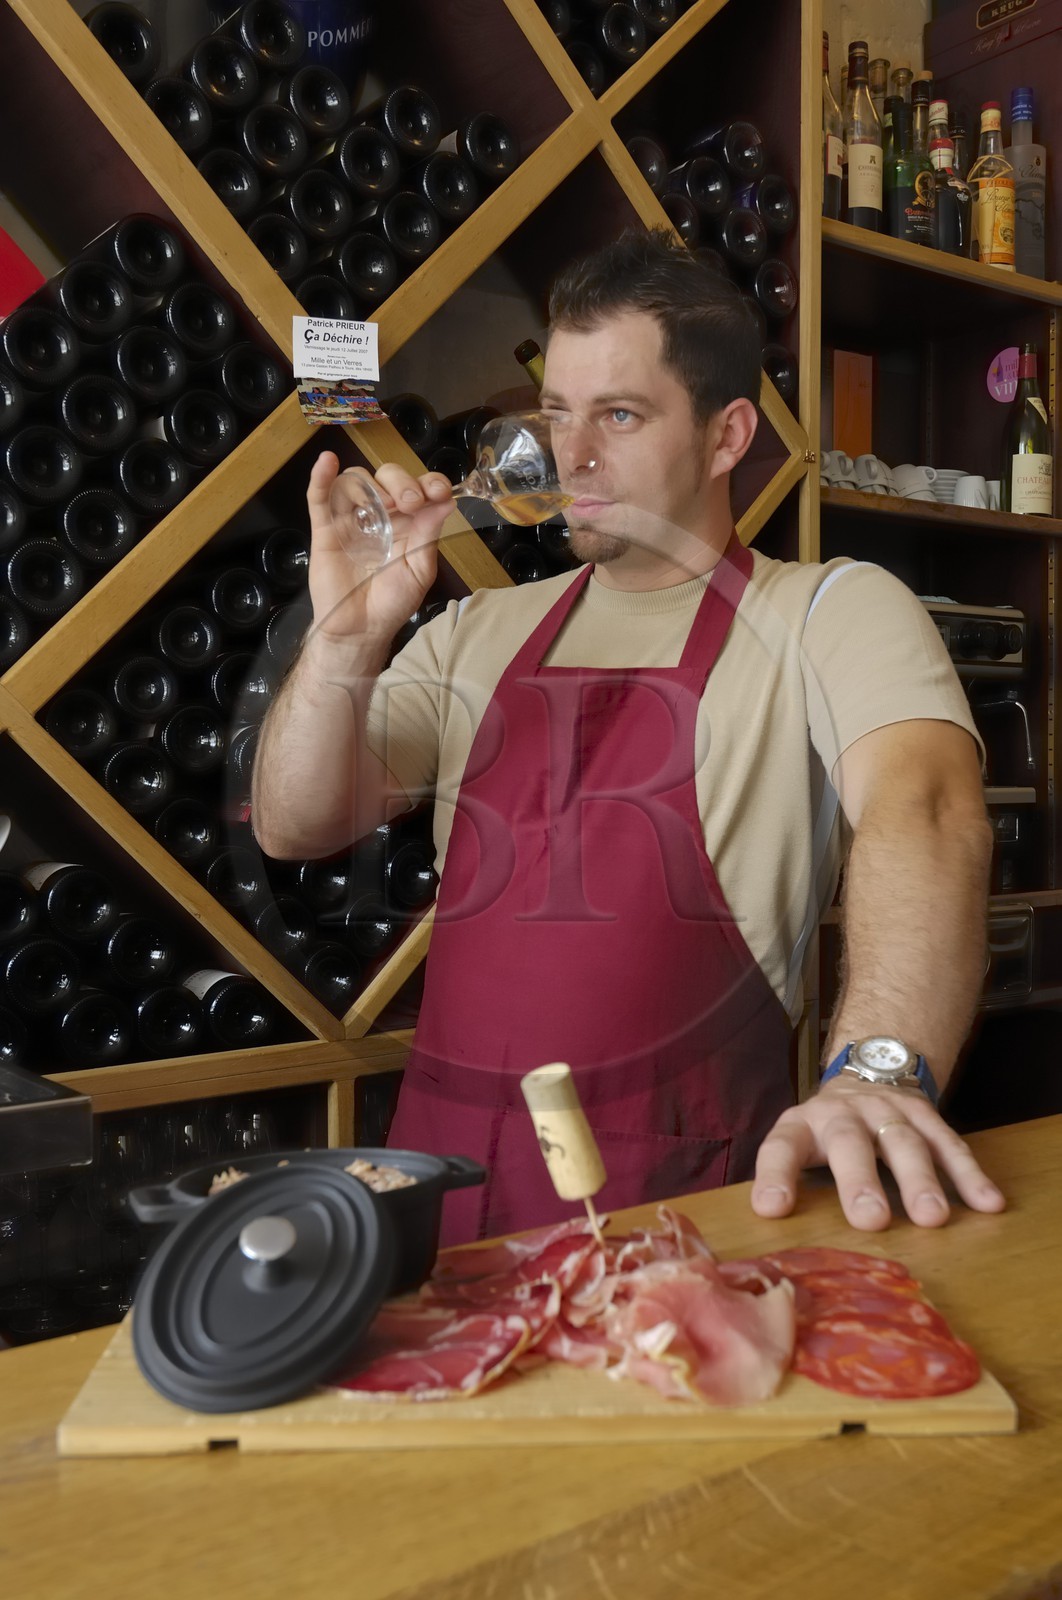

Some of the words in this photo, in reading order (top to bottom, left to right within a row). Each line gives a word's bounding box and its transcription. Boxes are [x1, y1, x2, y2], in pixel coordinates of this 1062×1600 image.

[307, 15, 373, 48] POMMER
[307, 319, 333, 328] Patrick
[336, 321, 365, 331] PRIEUR
[304, 329, 320, 344] Ça
[323, 332, 363, 345] Déchire
[365, 336, 369, 345] !
[343, 359, 363, 367] Verres
